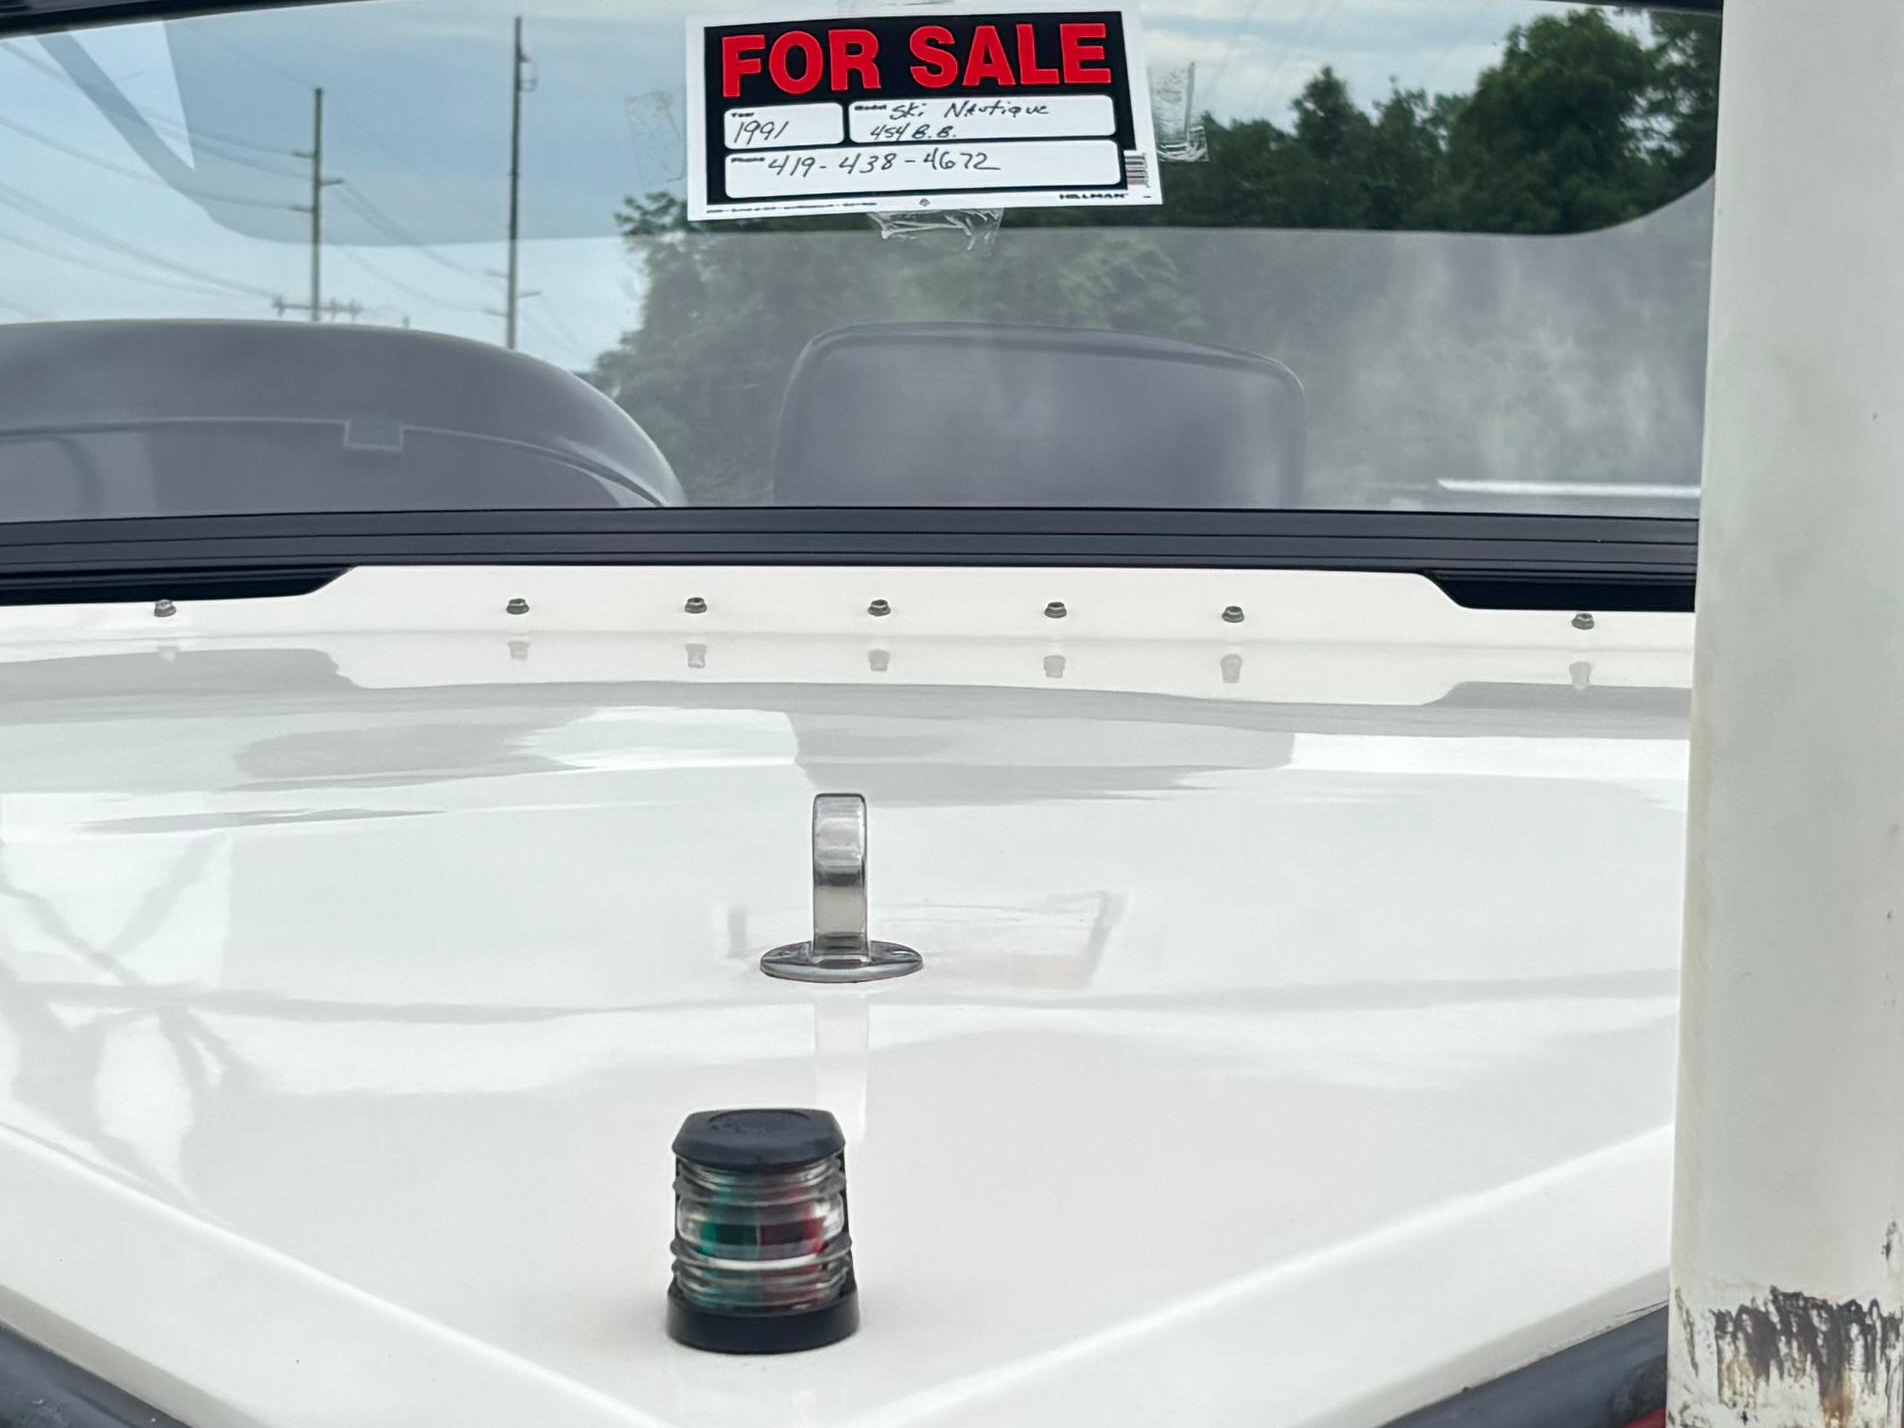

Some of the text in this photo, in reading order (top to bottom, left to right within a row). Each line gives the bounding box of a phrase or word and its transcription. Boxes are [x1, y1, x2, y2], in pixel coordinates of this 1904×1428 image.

[721, 22, 1113, 99] FOR SALE
[733, 119, 790, 146] 1991
[869, 122, 911, 142] 454
